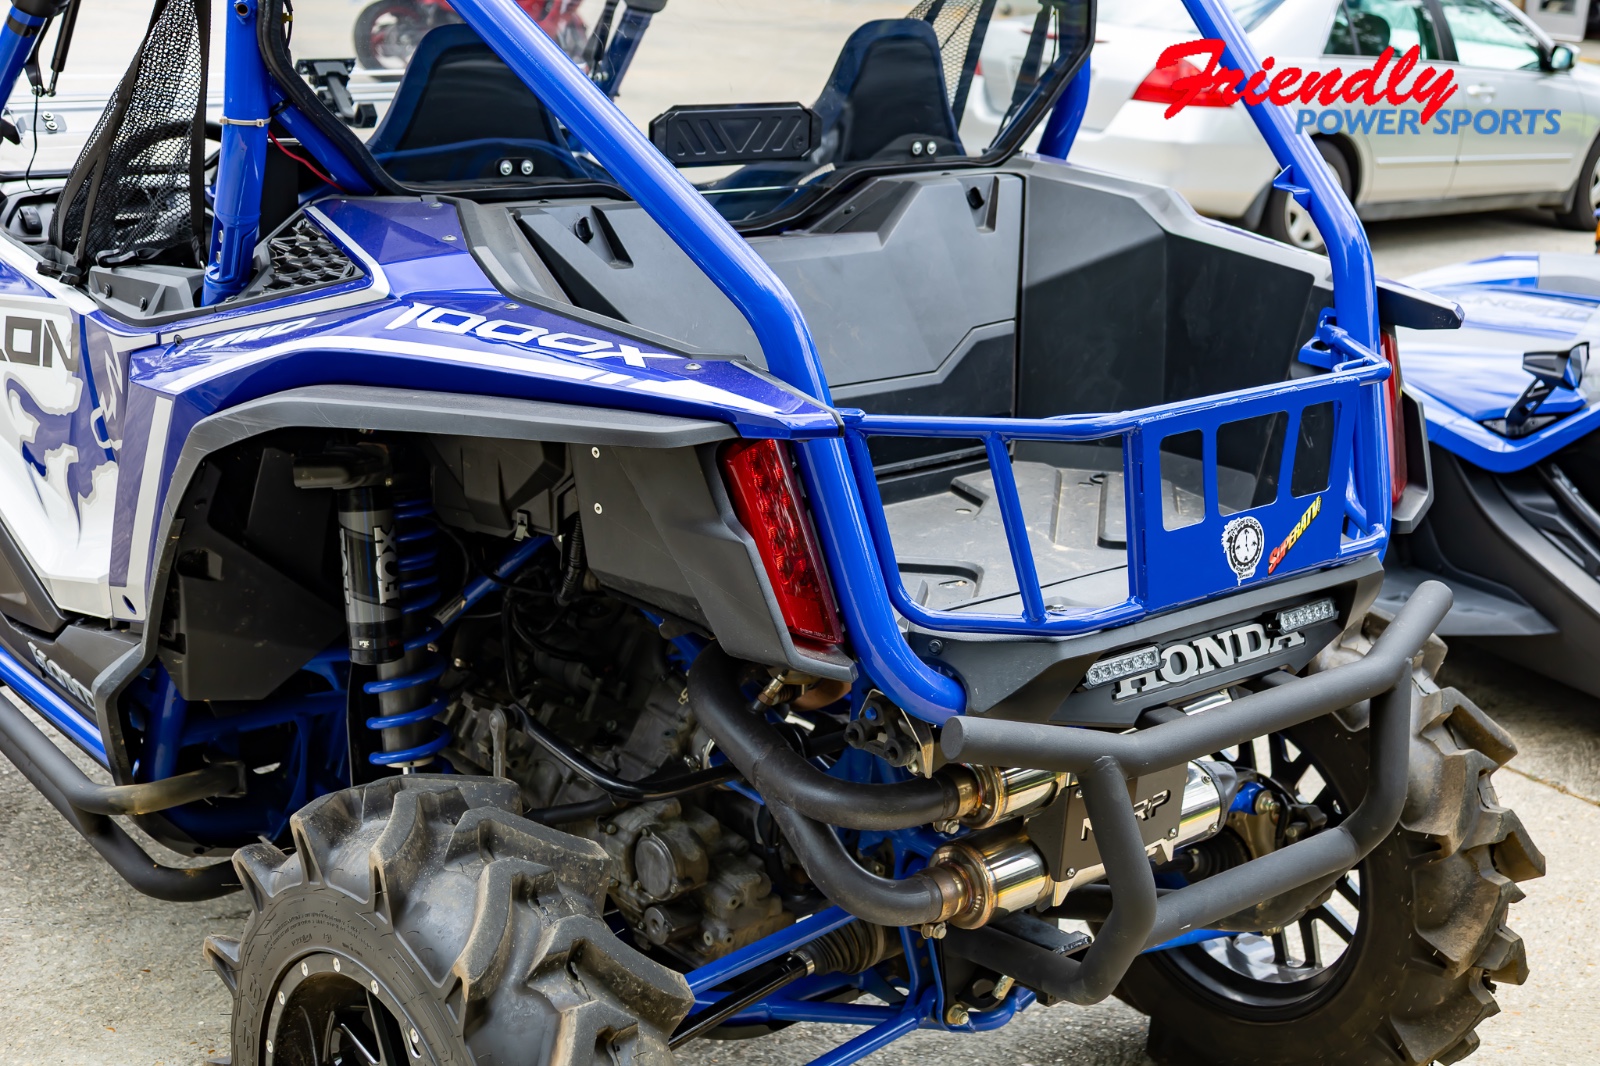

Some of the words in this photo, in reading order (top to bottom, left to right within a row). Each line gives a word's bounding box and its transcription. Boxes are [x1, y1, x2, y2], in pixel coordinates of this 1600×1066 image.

[0, 316, 80, 373] ON
[385, 302, 685, 368] 1000X
[27, 641, 96, 711] HOND
